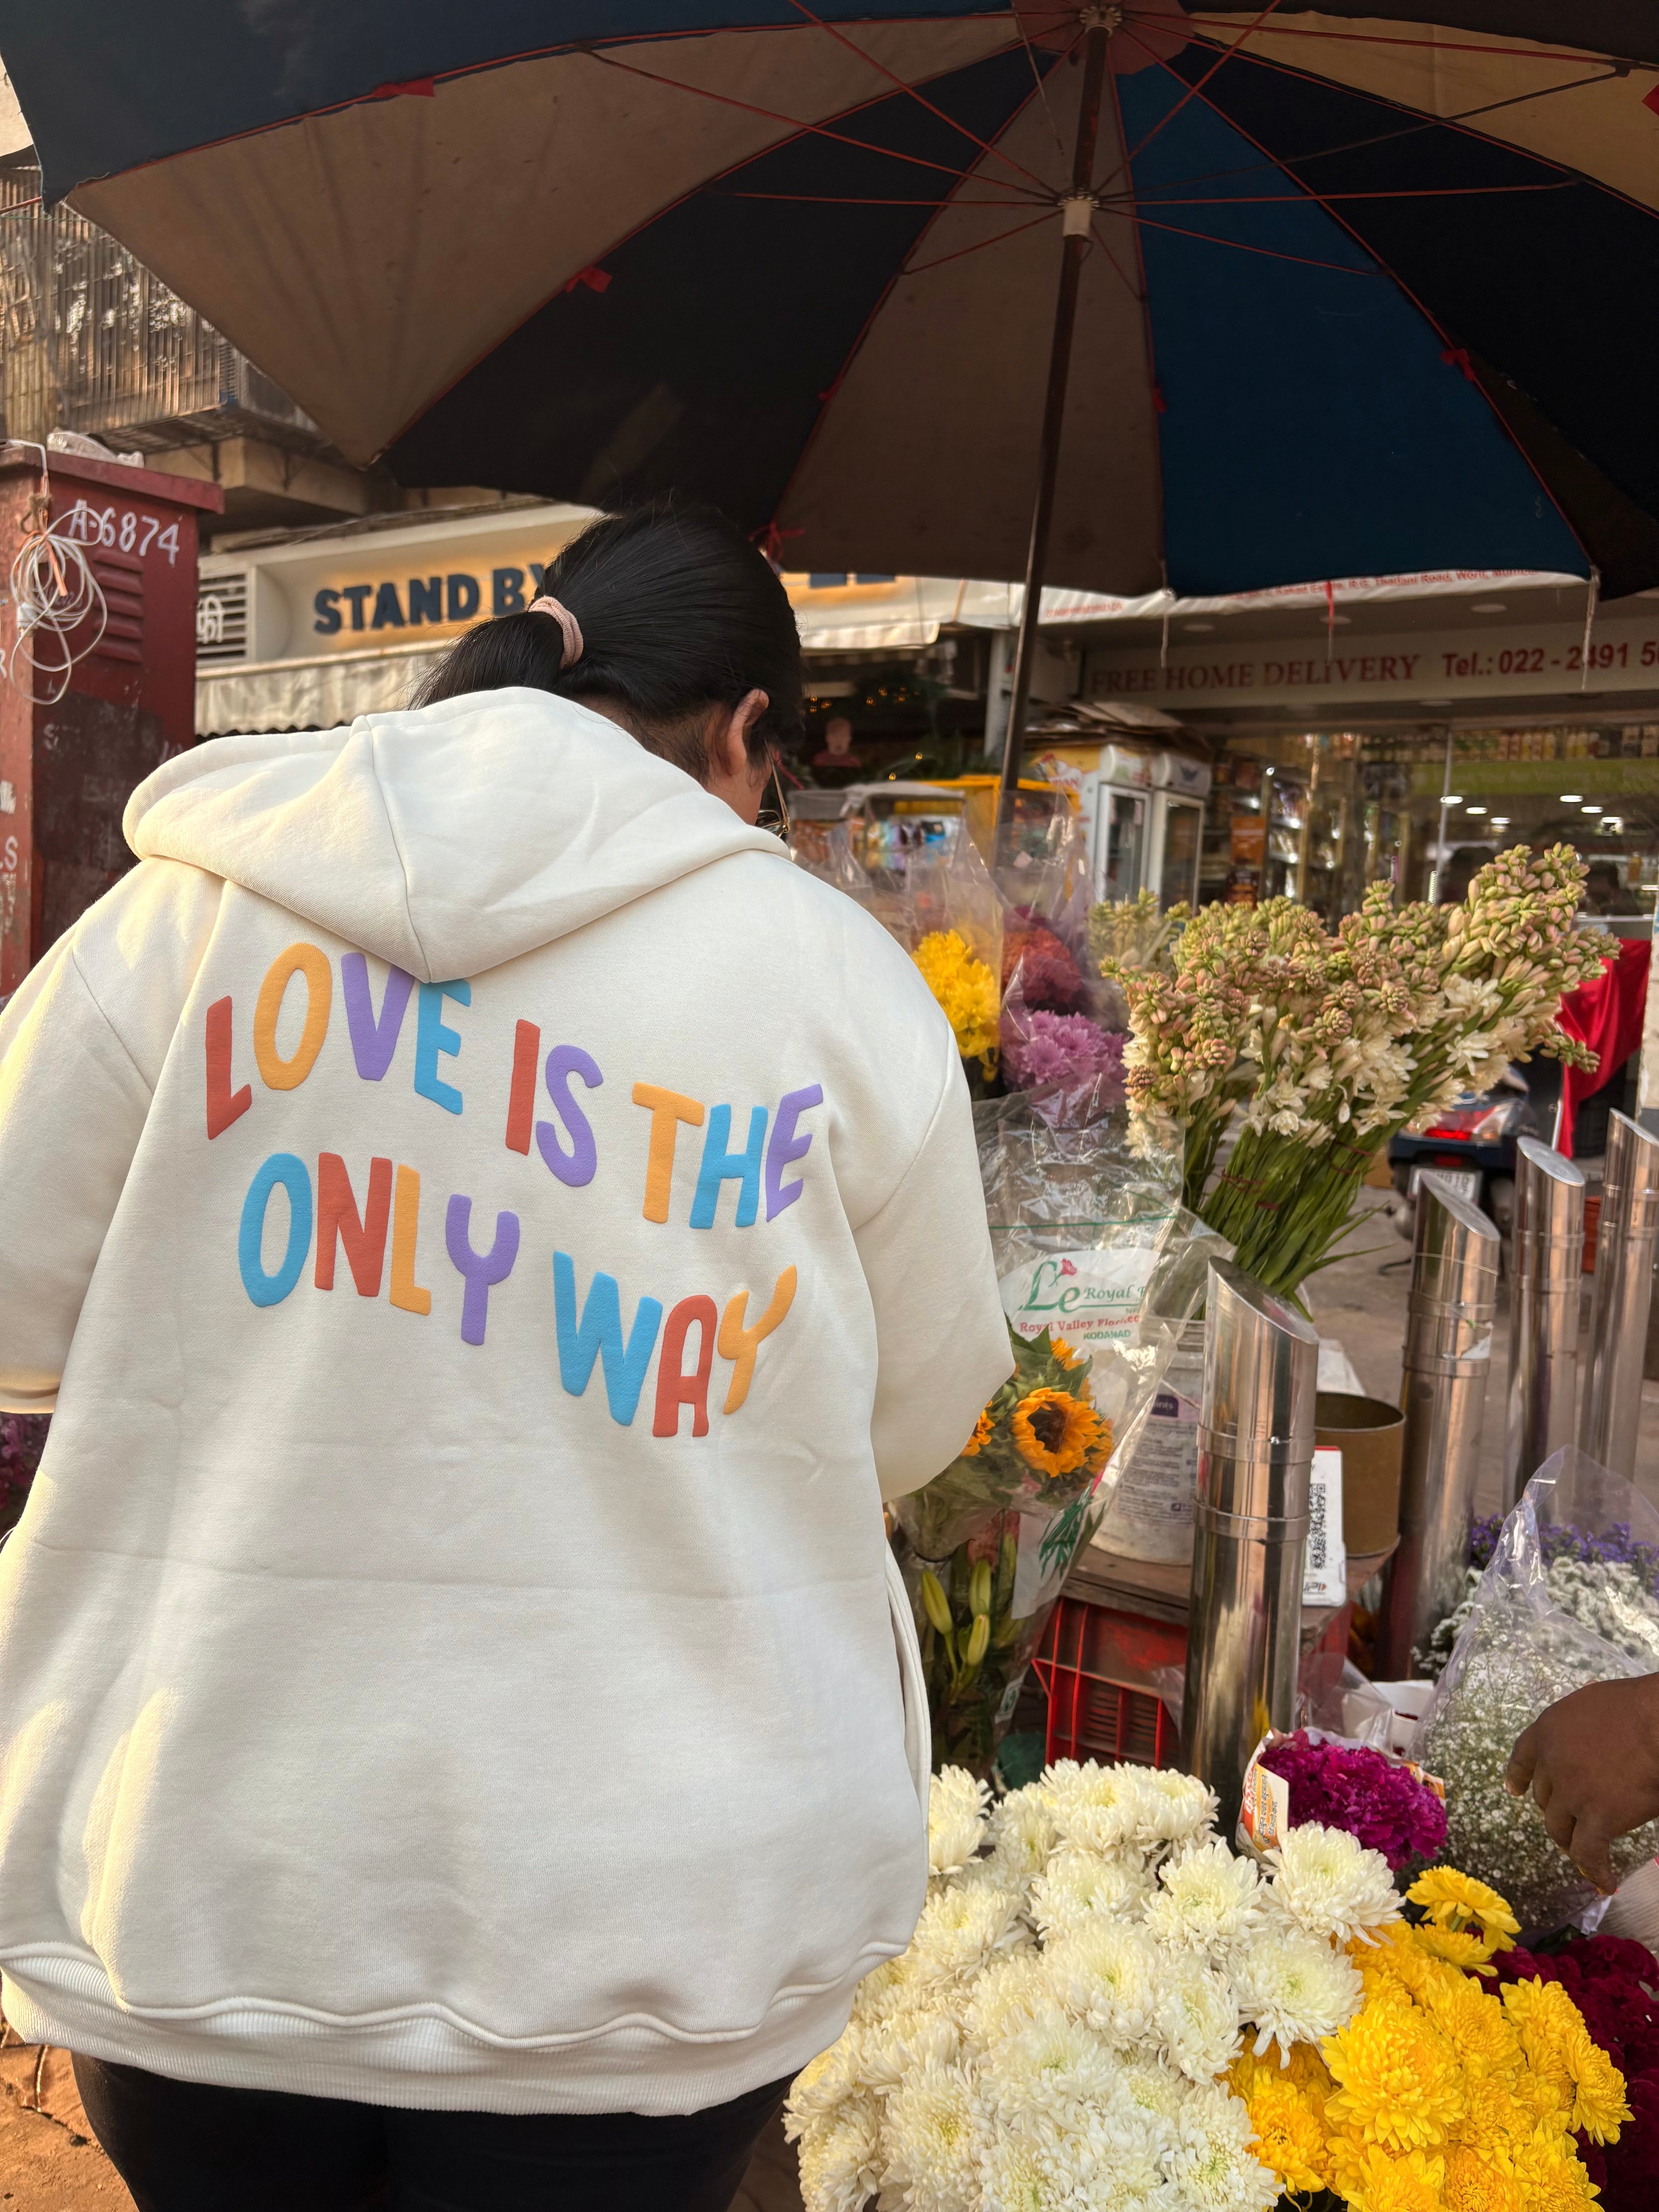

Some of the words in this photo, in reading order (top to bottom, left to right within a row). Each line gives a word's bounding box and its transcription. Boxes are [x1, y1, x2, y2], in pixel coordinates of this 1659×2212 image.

[68, 499, 180, 565] A-6874
[314, 574, 480, 634] STAND
[1091, 669, 1156, 691] FREE
[1168, 663, 1252, 689] HOME
[1264, 654, 1420, 685] DELIVERY
[1641, 641, 1659, 666] 5
[206, 943, 471, 1140] LOVE
[505, 1019, 604, 1186] IS
[632, 1082, 823, 1229] THE
[238, 1153, 519, 1345] ONLY
[553, 1251, 798, 1437] WAY
[1017, 1261, 1080, 1313] Le
[1084, 1285, 1135, 1302] Royal
[1057, 1320, 1094, 1330] Valley
[1084, 1329, 1131, 1339] KODANAD
